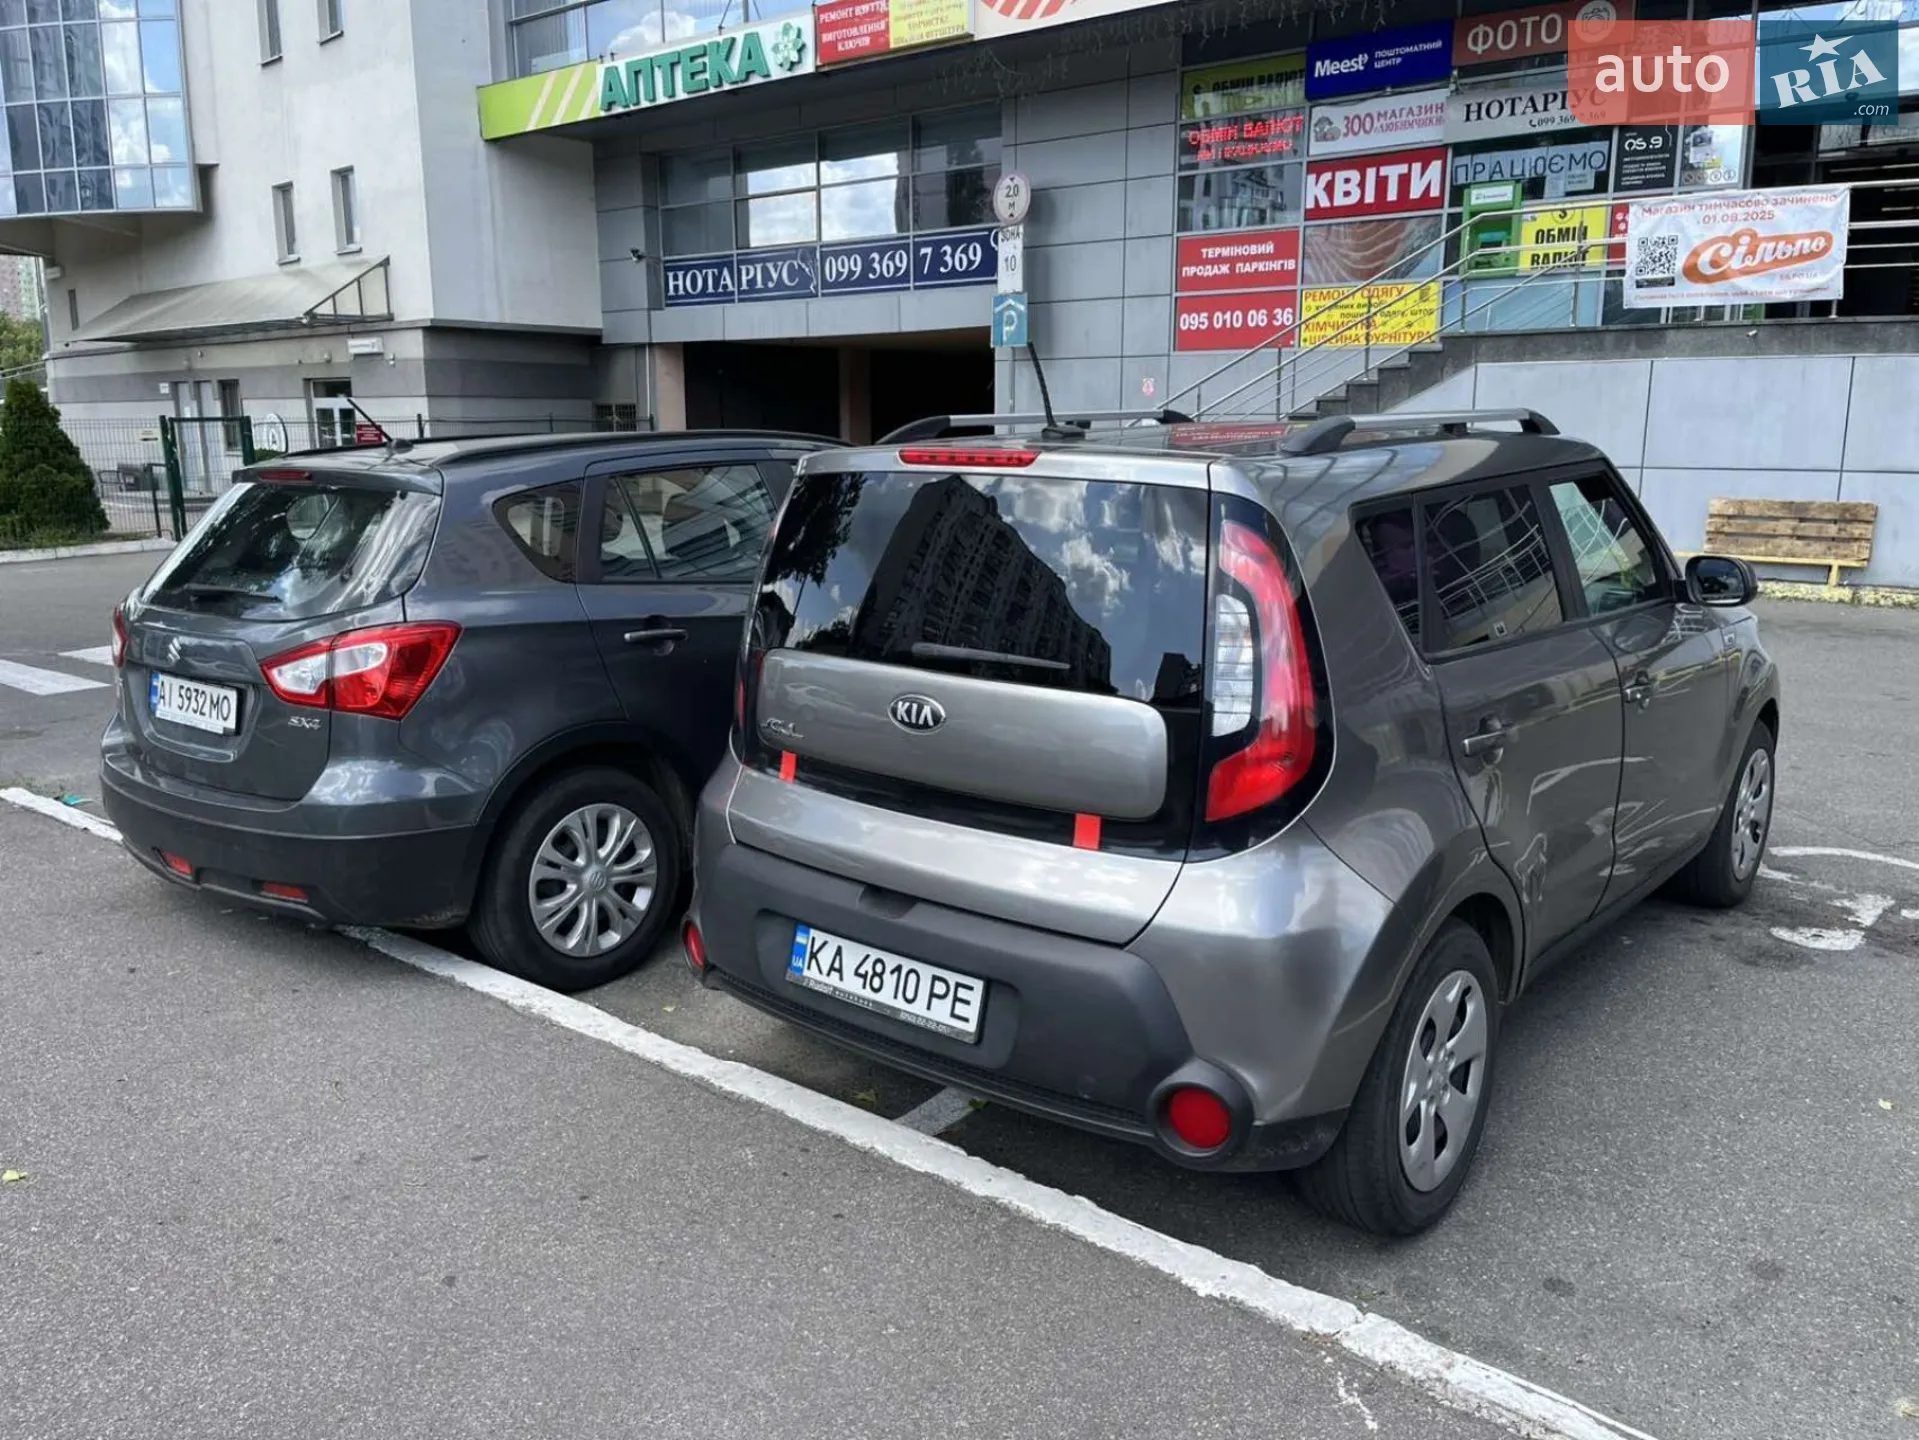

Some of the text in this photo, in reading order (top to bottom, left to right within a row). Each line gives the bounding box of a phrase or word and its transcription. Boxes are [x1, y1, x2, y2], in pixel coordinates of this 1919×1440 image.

[1466, 15, 1563, 55] ФОТО
[1374, 40, 1443, 59] ПОШТОМАТНИЙ
[600, 31, 771, 111] АПТЕКА
[1314, 53, 1368, 78] Meest
[1374, 57, 1402, 69] ЦЕНТР
[1376, 102, 1445, 121] МАГАЗИН
[1464, 87, 1607, 123] НОТАРІУС
[1537, 117, 1555, 127] 099
[1557, 114, 1576, 125] 369
[1453, 149, 1606, 184] ПРАЦЮЄМО
[1305, 159, 1443, 210] КВІТИ
[1642, 193, 1838, 216] Магазин тимчасово зачинено
[1702, 210, 1775, 225] 01.08.2025
[1535, 225, 1588, 245] ОБМІН
[1201, 241, 1274, 259] ТЕРМІНОВИЙ
[1697, 234, 1827, 276] Сільпо
[824, 243, 982, 283] 099 369 7 369
[1004, 254, 1017, 271] 10
[1182, 259, 1296, 277] ПРОДАЖ ПАРКІНГІВ
[666, 259, 799, 297] НОТАРІУС
[1360, 286, 1405, 299] ОДЯГУ
[1179, 307, 1294, 331] 095 010 06 36
[159, 679, 231, 722] AI 5932 MO
[896, 700, 934, 726] KIA
[792, 955, 803, 968] UA
[807, 936, 975, 1024] KA 4810 PE
